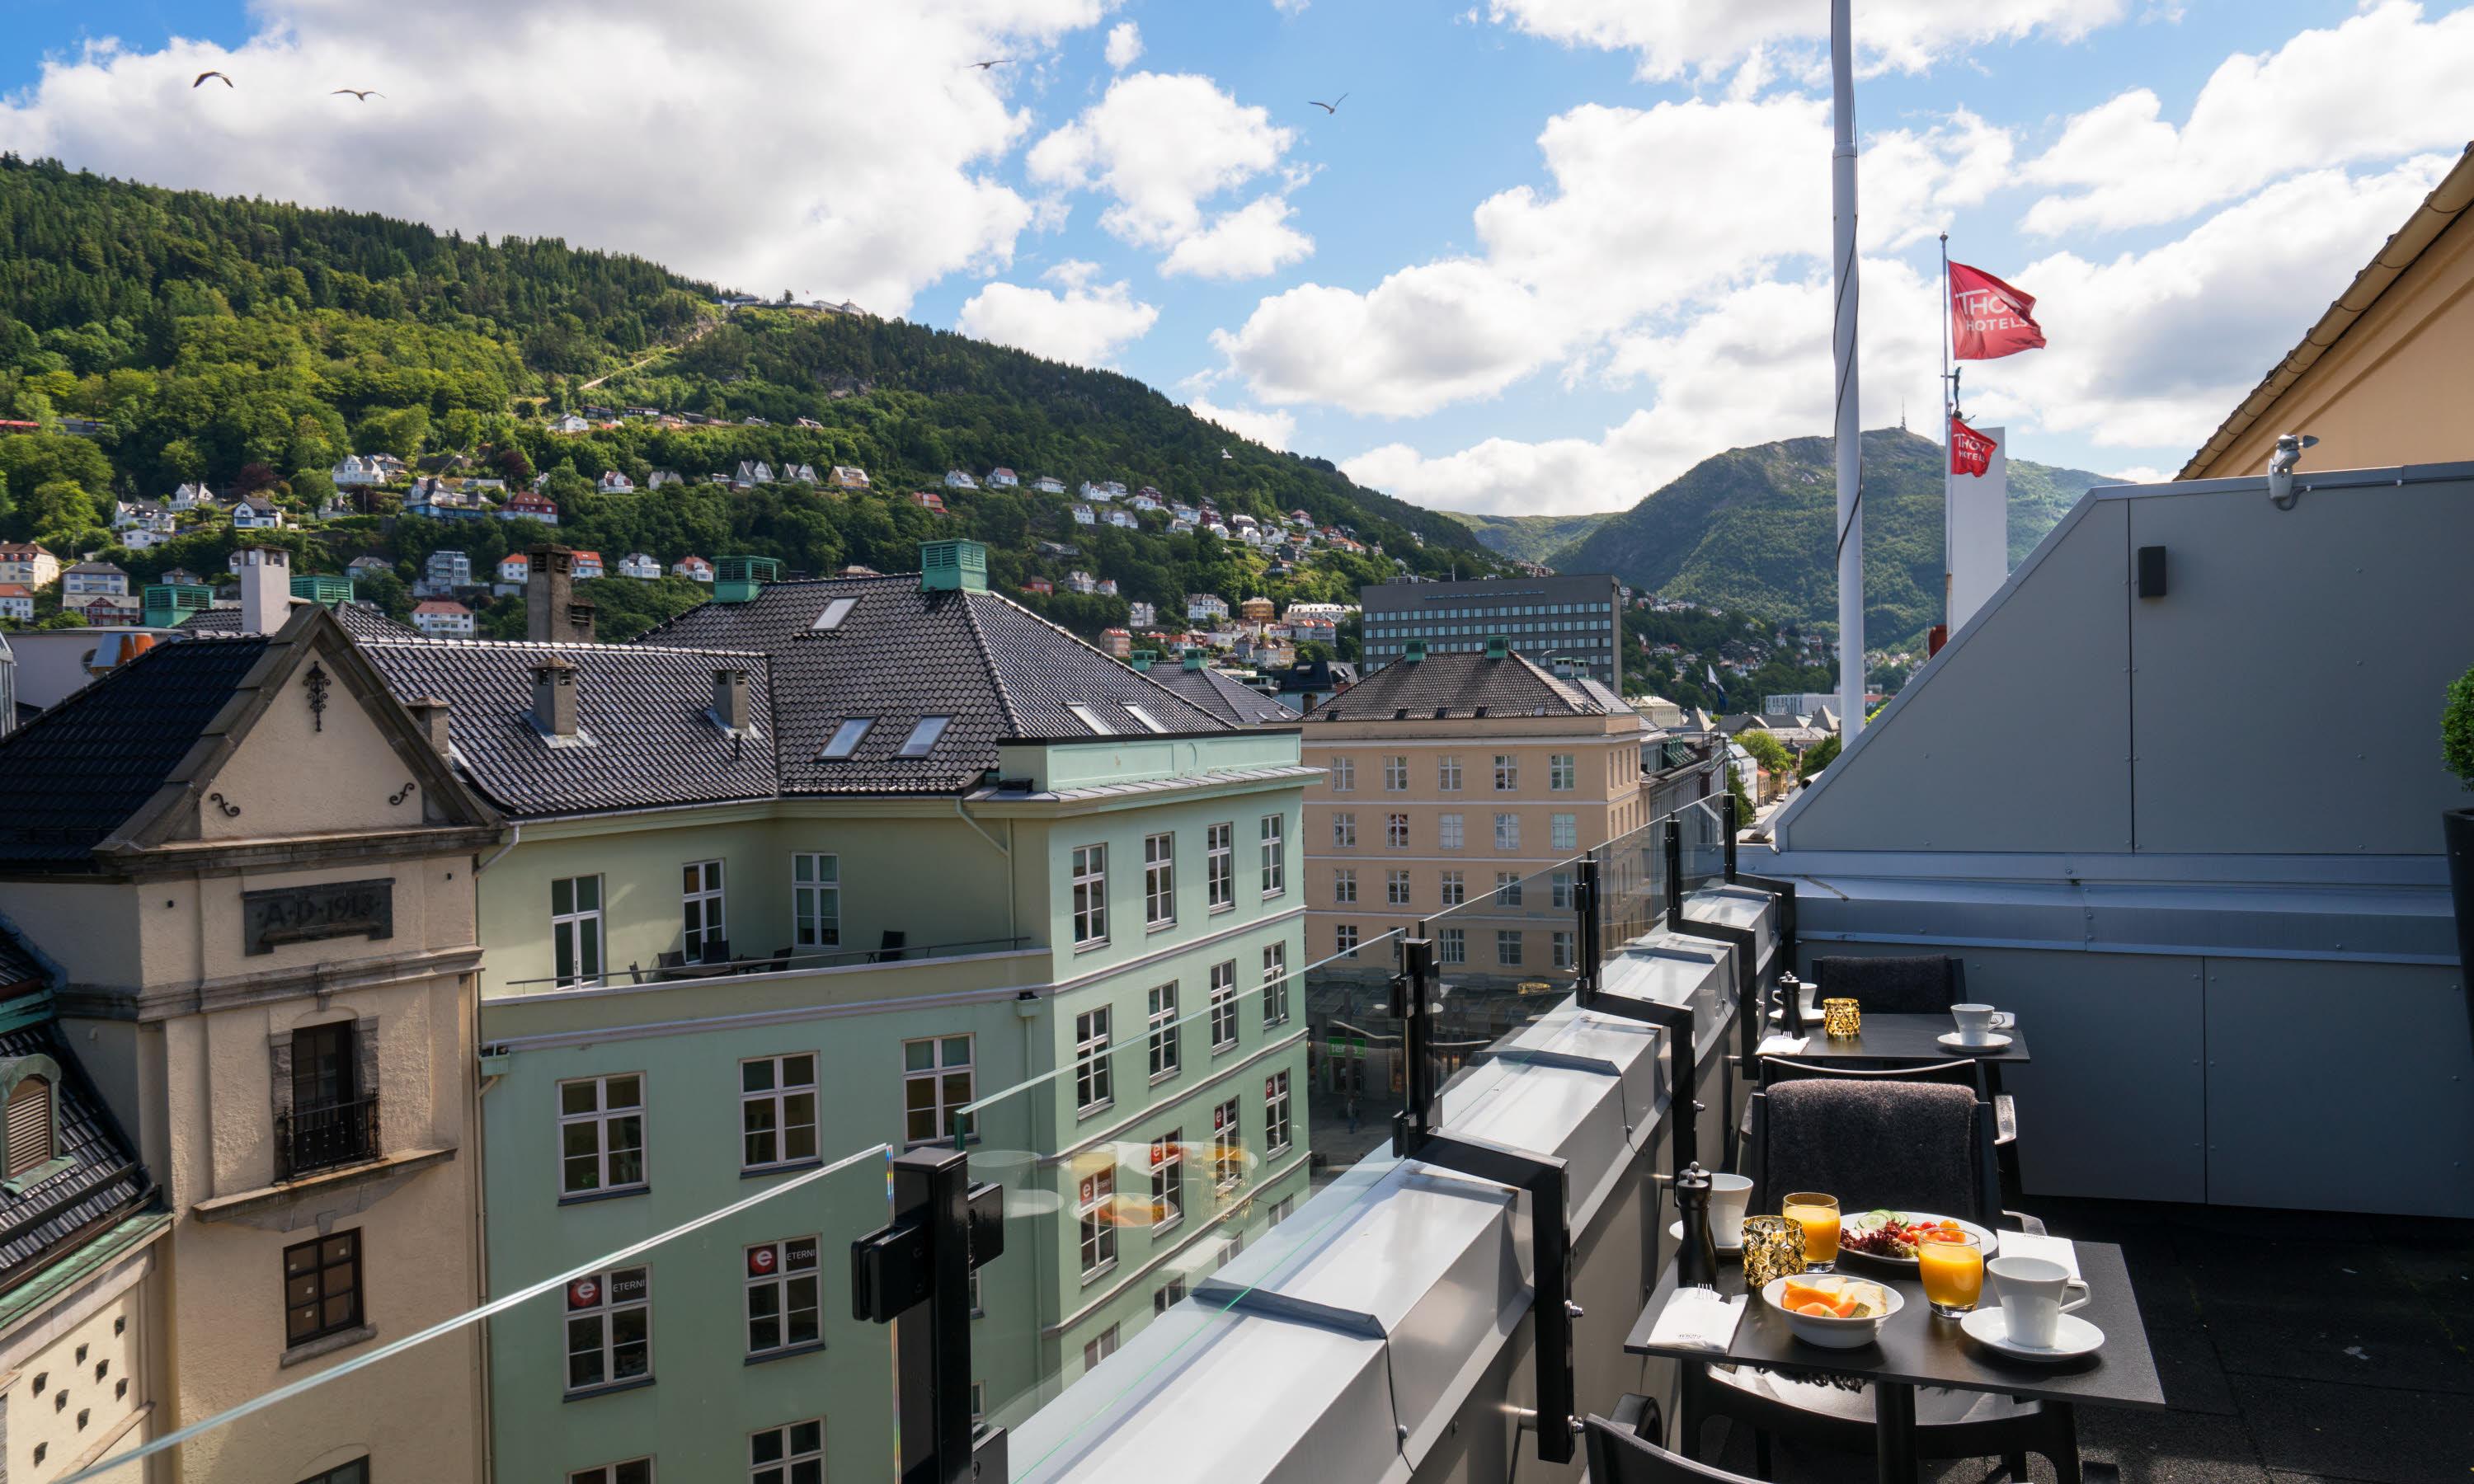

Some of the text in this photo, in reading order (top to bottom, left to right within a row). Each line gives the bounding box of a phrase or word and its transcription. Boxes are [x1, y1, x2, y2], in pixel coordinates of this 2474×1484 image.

[1954, 289, 2020, 316] THO
[757, 1251, 773, 1266] e
[577, 1282, 595, 1299] e
